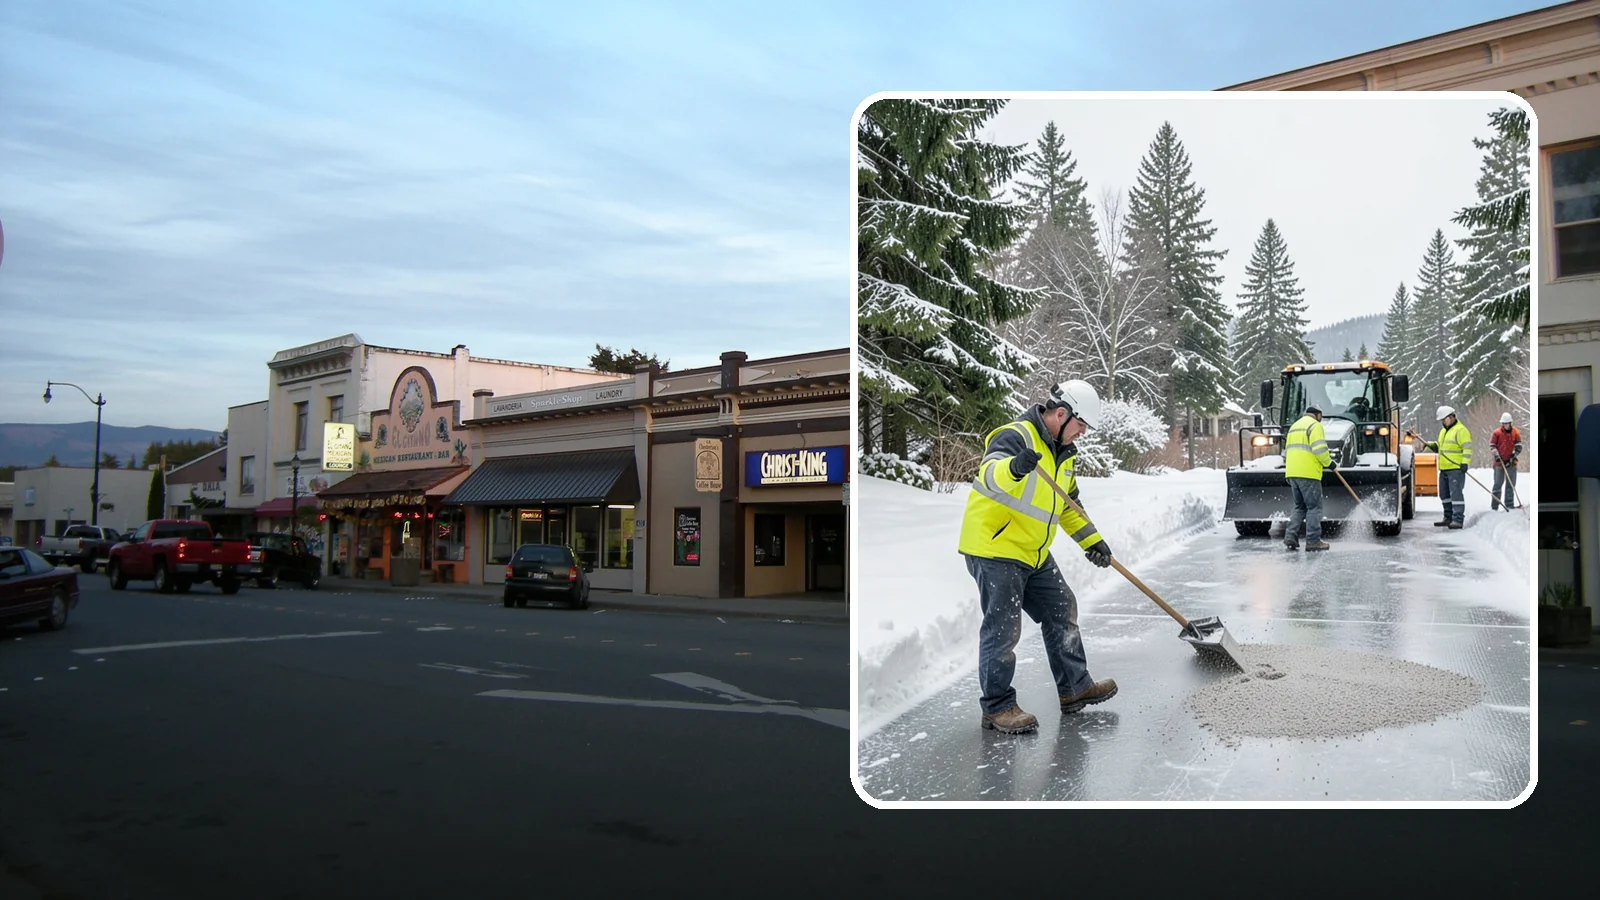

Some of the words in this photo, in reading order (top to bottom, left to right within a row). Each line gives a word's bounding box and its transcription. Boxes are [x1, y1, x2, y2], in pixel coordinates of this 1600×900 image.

[493, 402, 523, 413] LAVANDERIA
[530, 396, 561, 409] Sparkle
[562, 394, 582, 406] Shop
[595, 389, 624, 400] LAUNDRY
[392, 425, 403, 450] EL
[373, 454, 396, 464] MEXICAN
[397, 451, 433, 462] RESTAURANT
[437, 450, 450, 459] BAR
[761, 452, 797, 477] CHRIST
[799, 450, 827, 476] KING
[696, 480, 709, 488] Coffee
